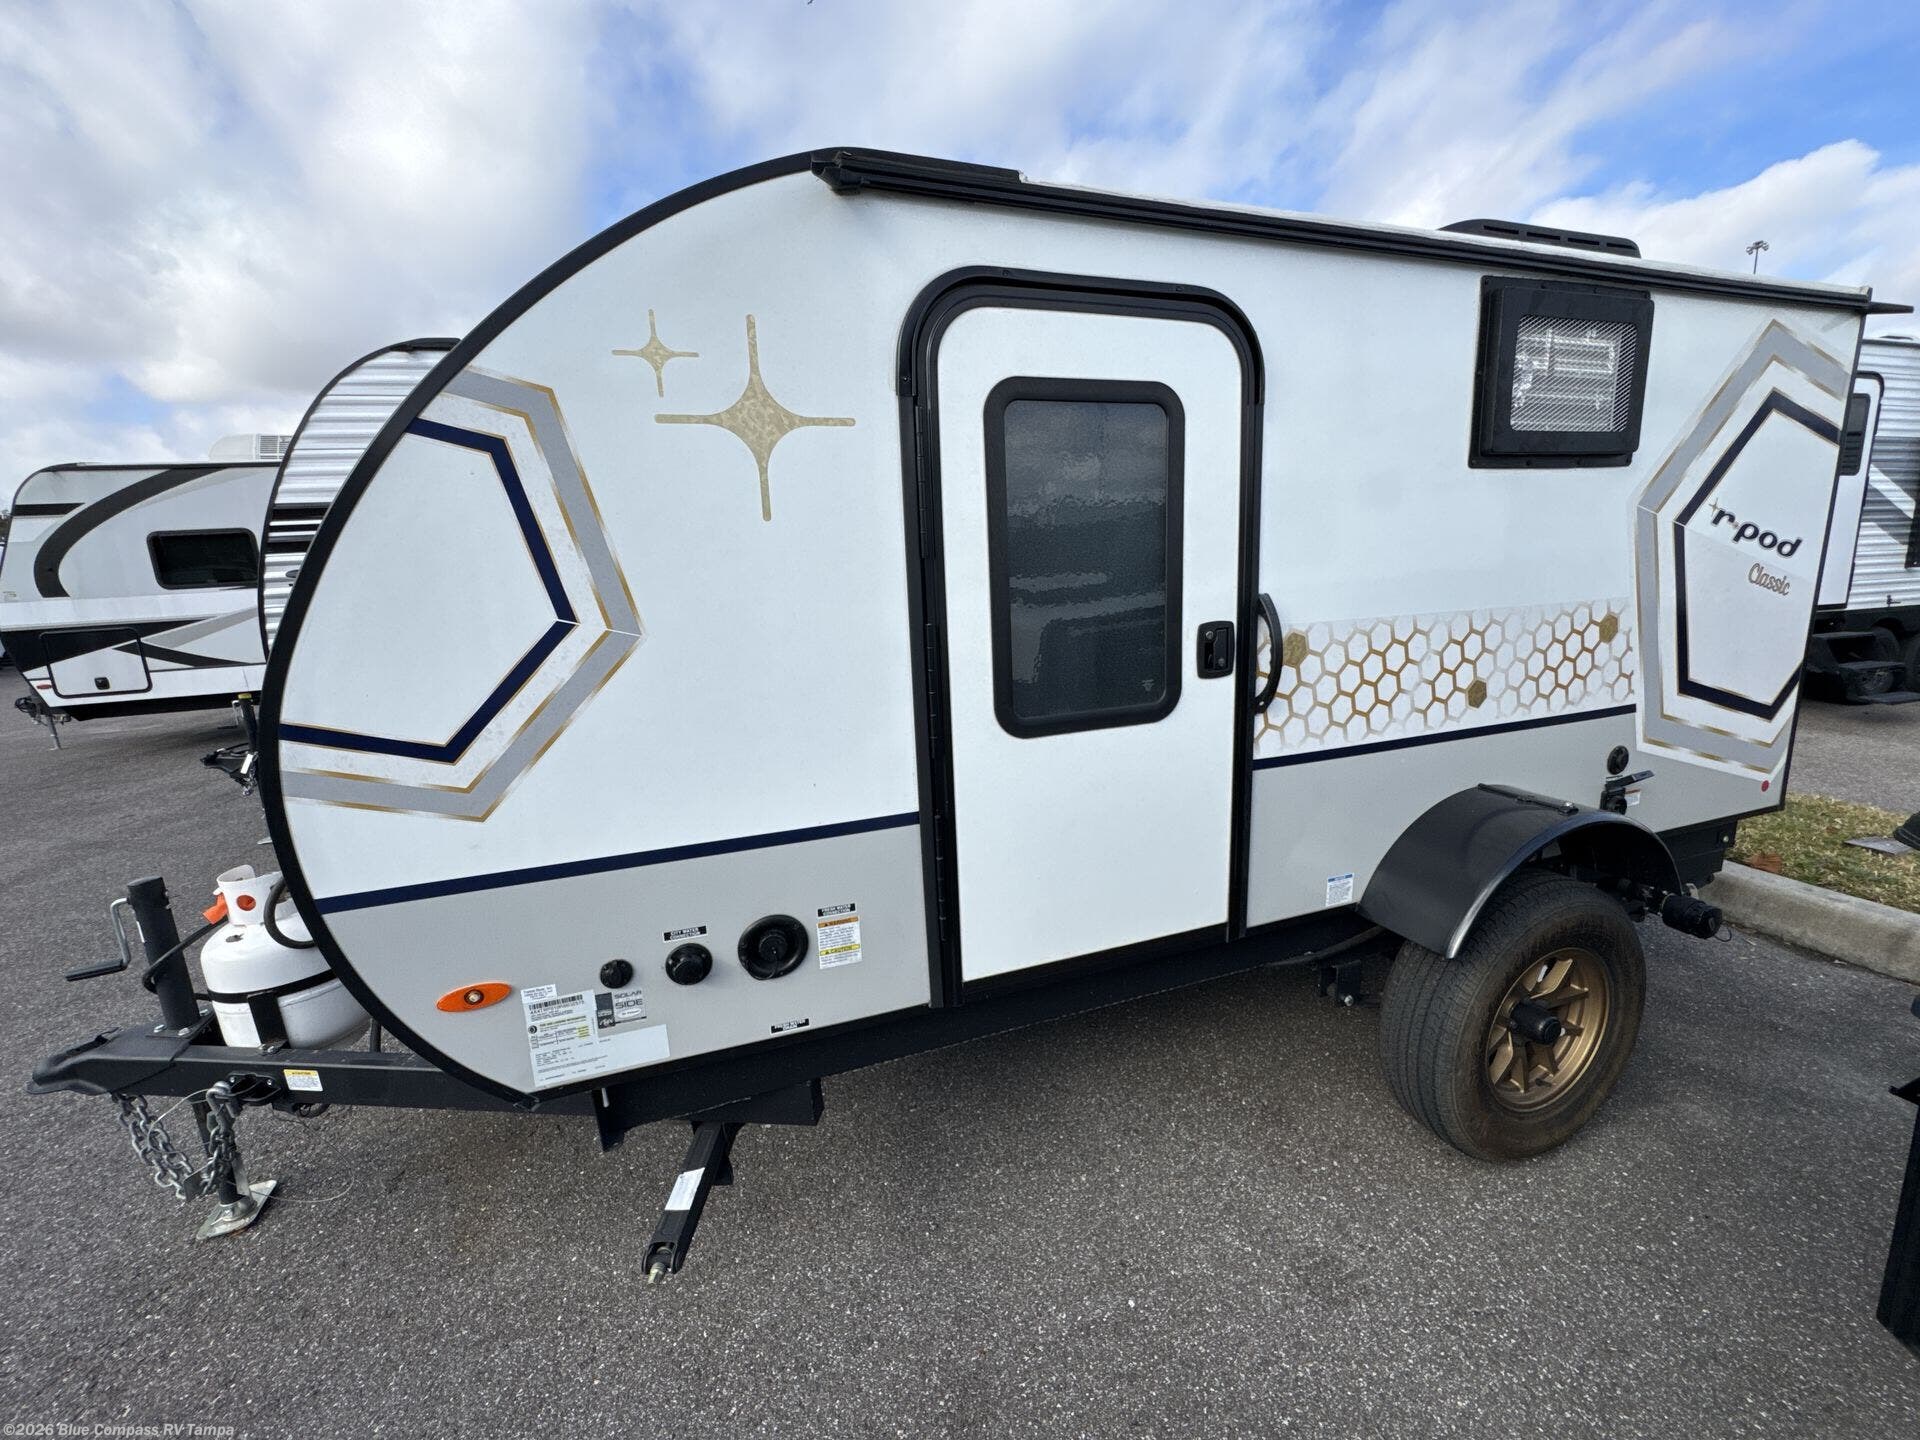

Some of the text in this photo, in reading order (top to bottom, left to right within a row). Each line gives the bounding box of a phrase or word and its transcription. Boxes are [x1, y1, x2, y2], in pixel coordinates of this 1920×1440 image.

[1747, 562, 1791, 596] Classic
[614, 989, 642, 999] SOLAR
[615, 998, 643, 1010] SIDE
